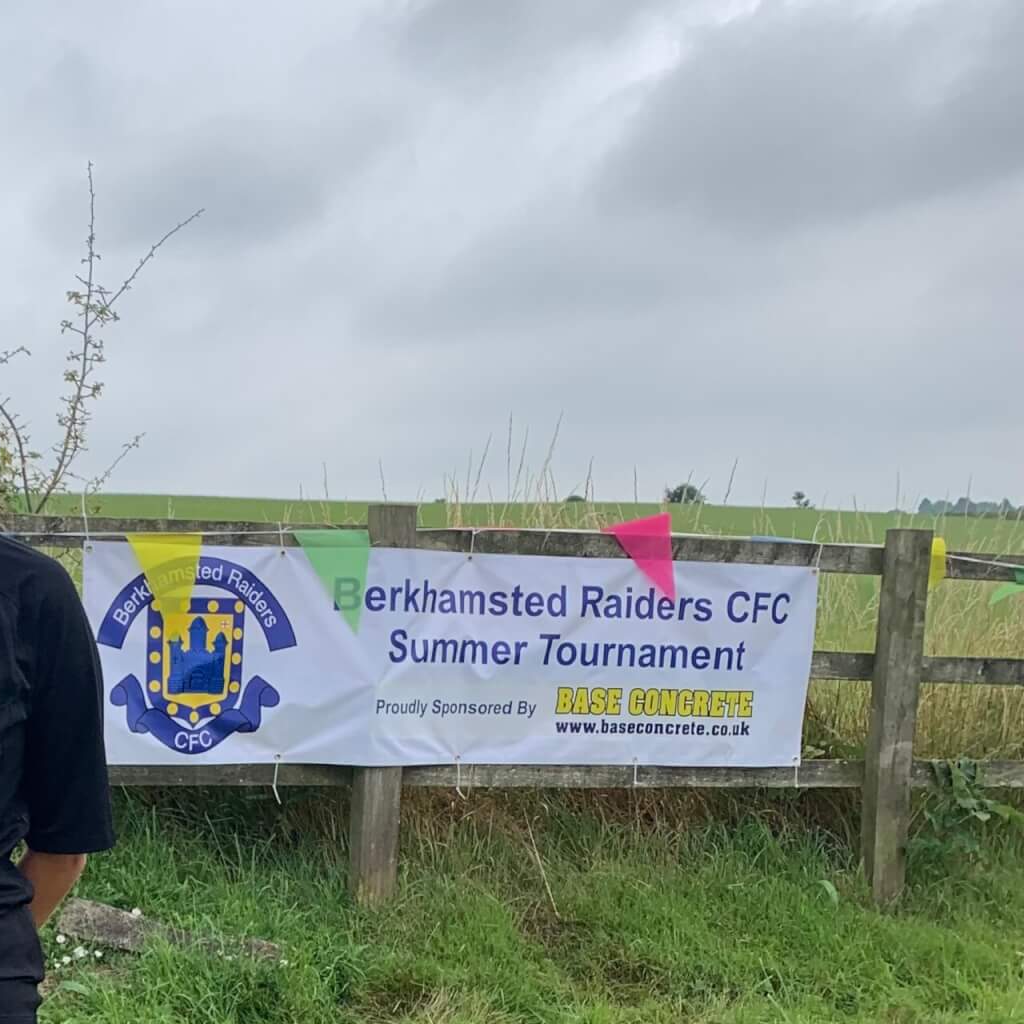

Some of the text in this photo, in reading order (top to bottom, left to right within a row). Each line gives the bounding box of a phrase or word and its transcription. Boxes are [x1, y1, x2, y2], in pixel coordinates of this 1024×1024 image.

[227, 568, 277, 629] Raiders
[333, 577, 791, 625] Berkhamsted Raiders CFC
[388, 629, 746, 671] Summer Tournament
[376, 699, 537, 718] Proudly Sponsored By
[555, 687, 754, 718] BASE CONCRETE
[174, 730, 213, 751] CFC
[555, 719, 750, 737] www.baseconcrete.co.uk
